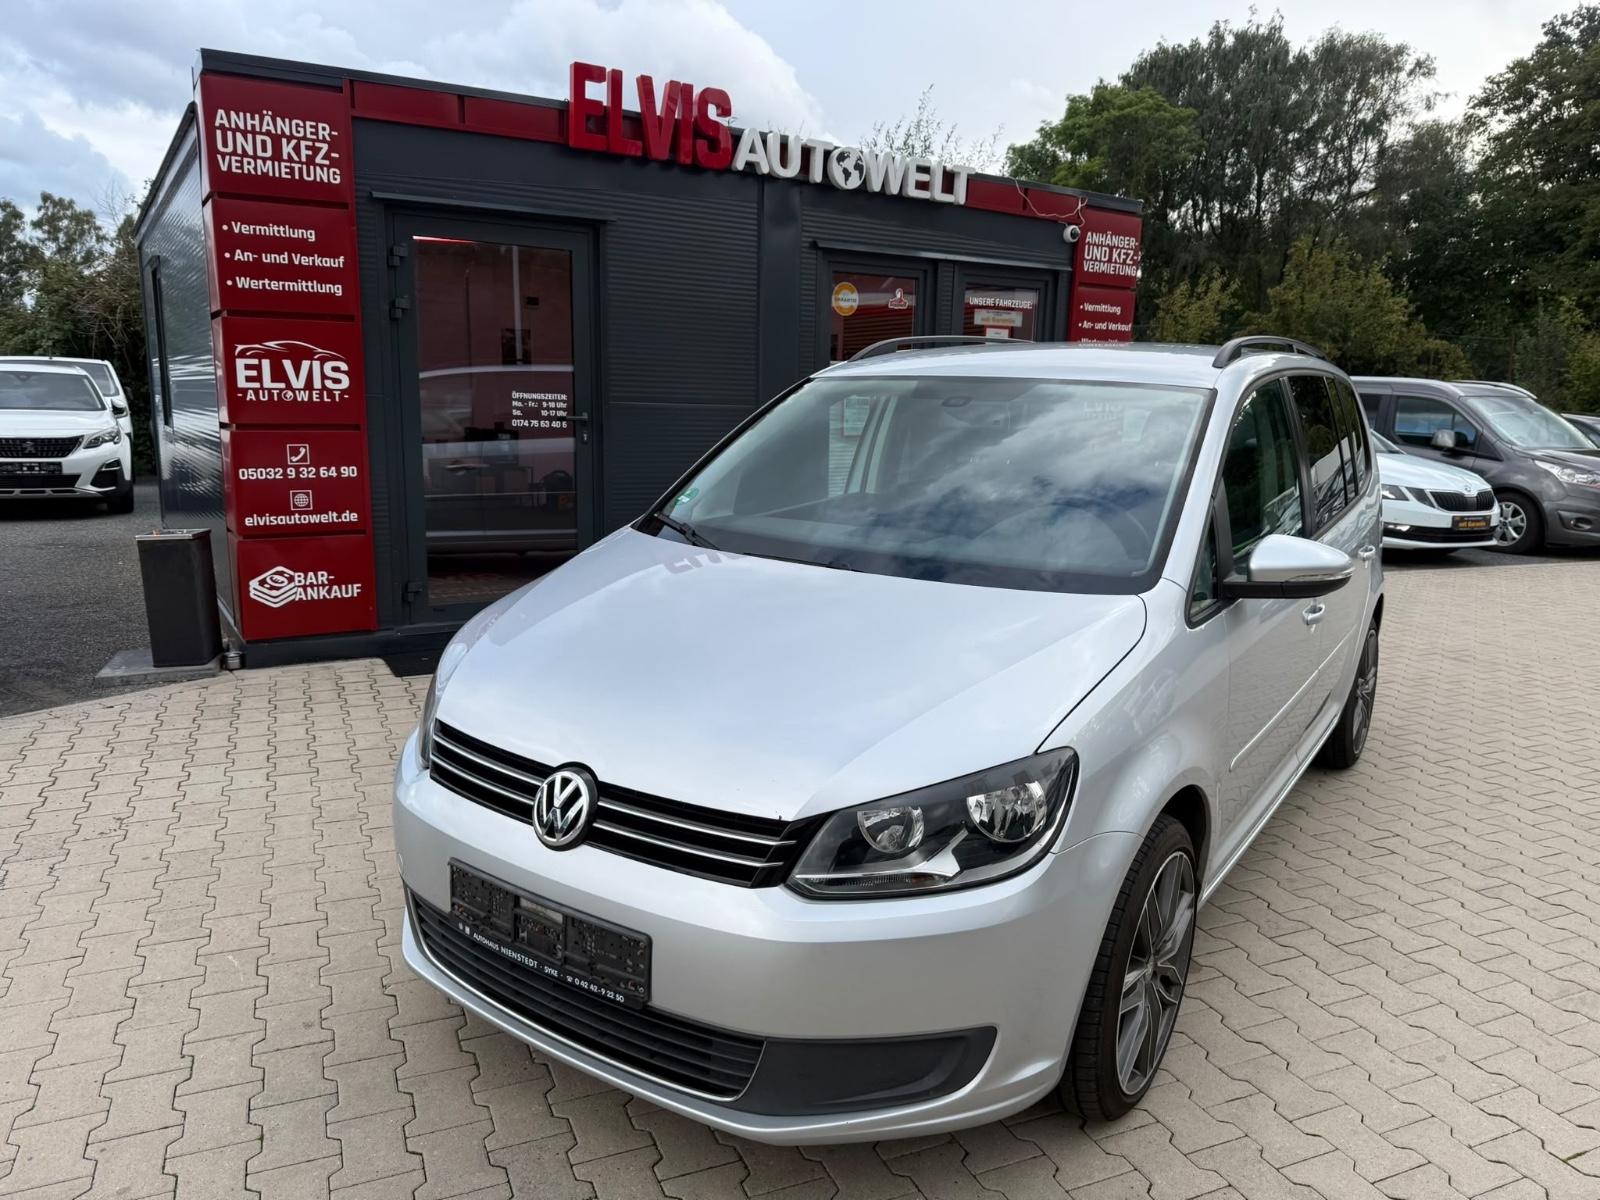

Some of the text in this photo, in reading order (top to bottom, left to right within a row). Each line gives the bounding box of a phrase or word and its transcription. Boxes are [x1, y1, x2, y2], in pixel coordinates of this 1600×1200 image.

[214, 108, 338, 141] ANHÄNGER-
[569, 61, 976, 206] ELVIS AUTOWELT
[215, 129, 340, 165] UND KFZ-
[216, 154, 341, 184] VERMIETUNG
[231, 221, 316, 242] Vermittlung
[1085, 231, 1139, 249] ANHÄNGER-
[234, 249, 345, 268] An- und Verkauf
[1084, 244, 1138, 264] UND KFZ-
[1083, 260, 1137, 277] VERMIETUNG
[235, 276, 343, 296] Wertermittlung
[969, 297, 995, 306] UNSERE
[1084, 302, 1121, 315] Vermittlung
[1082, 320, 1132, 331] An- und Verkauf
[234, 358, 350, 390] ELVIS
[511, 390, 568, 400] ÖFFNUNGSZEITEN:
[511, 419, 529, 427] 0174
[530, 420, 539, 428] 75
[540, 420, 550, 428] 63
[551, 420, 561, 428] 40
[239, 465, 358, 480] 05032 9 32 64 90
[244, 510, 359, 527] elvisautowelt.de
[294, 571, 335, 586] BAR-
[295, 583, 362, 601] ANKAUF
[473, 932, 500, 951] AUTOHAUS
[500, 946, 538, 969] NIENSTEDT
[544, 965, 559, 978] SYKE
[580, 979, 589, 989] 42
[606, 989, 615, 999] 22
[615, 993, 625, 1003] 50
